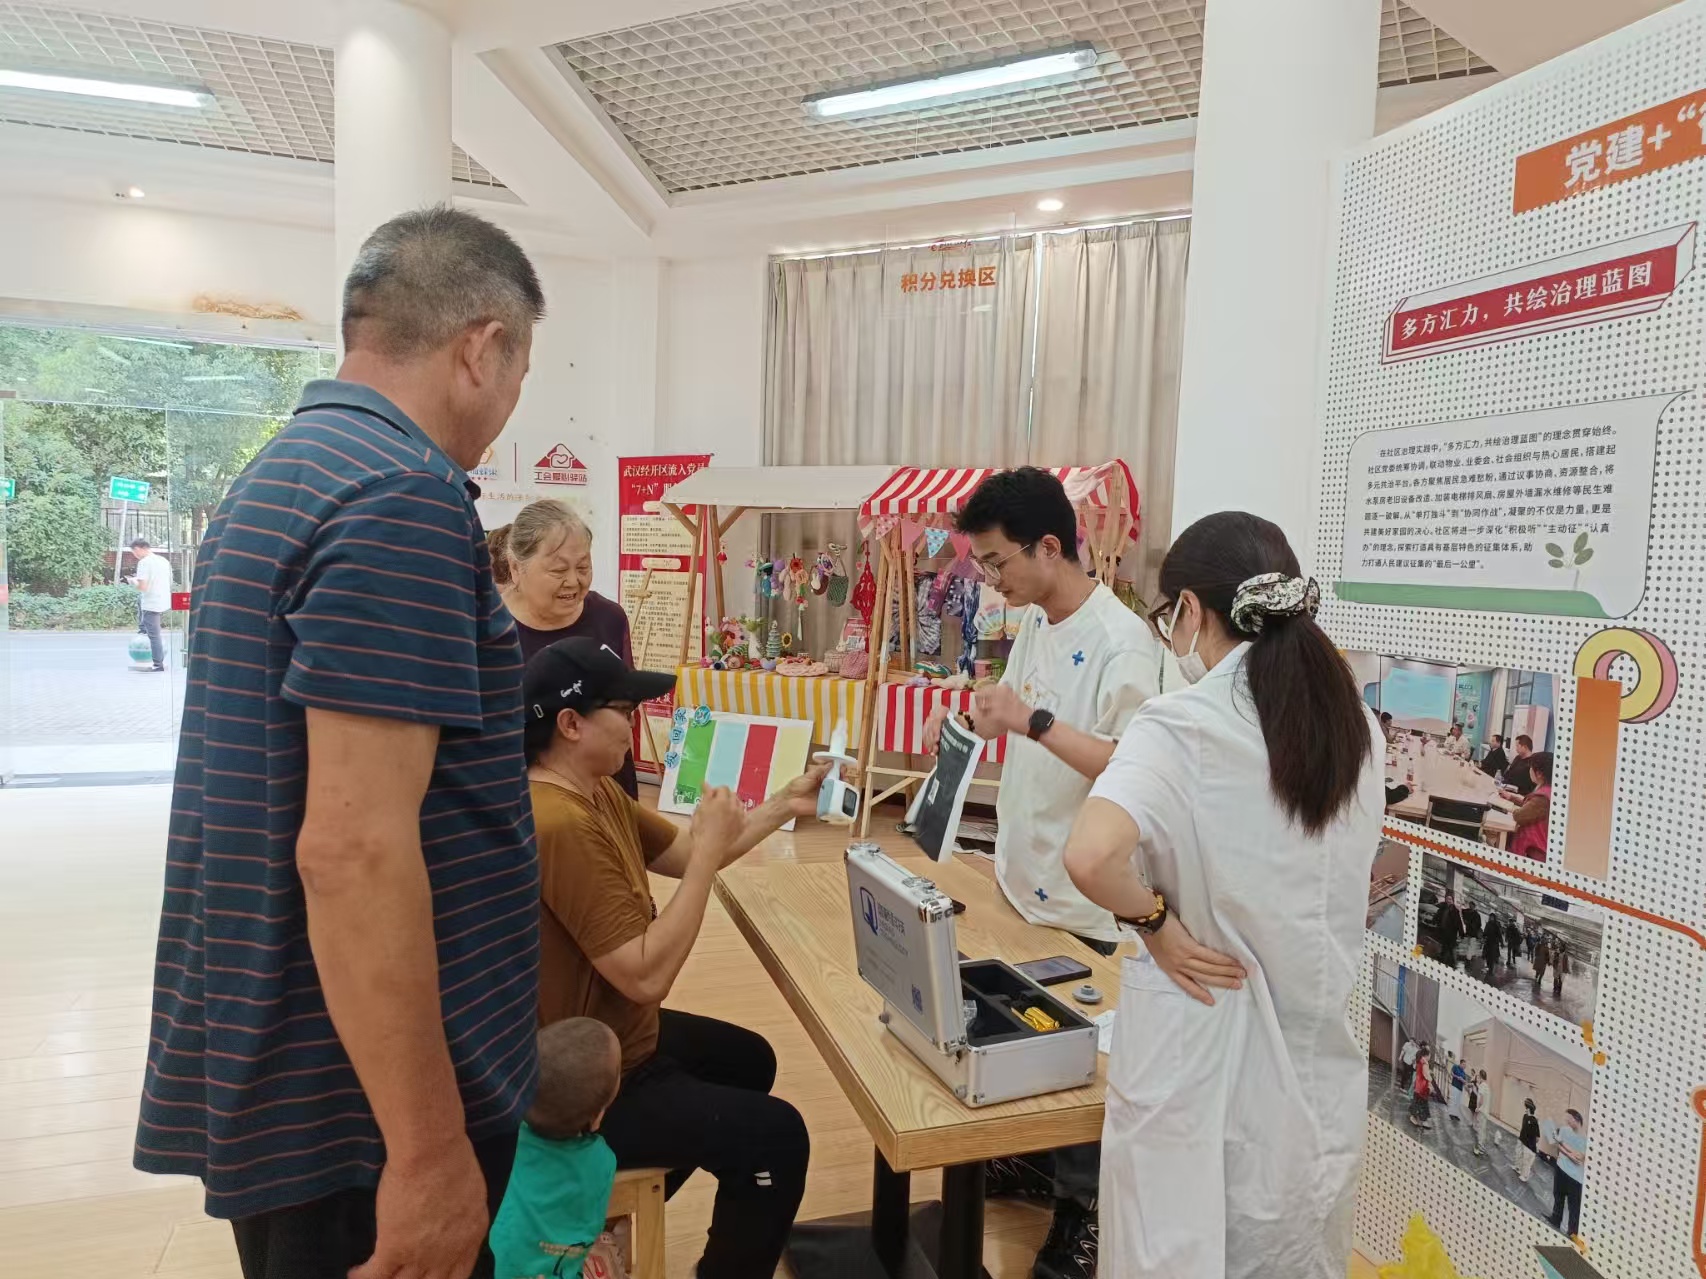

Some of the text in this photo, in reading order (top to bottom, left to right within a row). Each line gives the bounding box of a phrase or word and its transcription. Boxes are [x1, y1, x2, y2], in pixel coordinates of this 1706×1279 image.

[900, 266, 996, 293] 积分兑换区
[1401, 261, 1652, 341] 多方汇力，共绘治理蓝图
